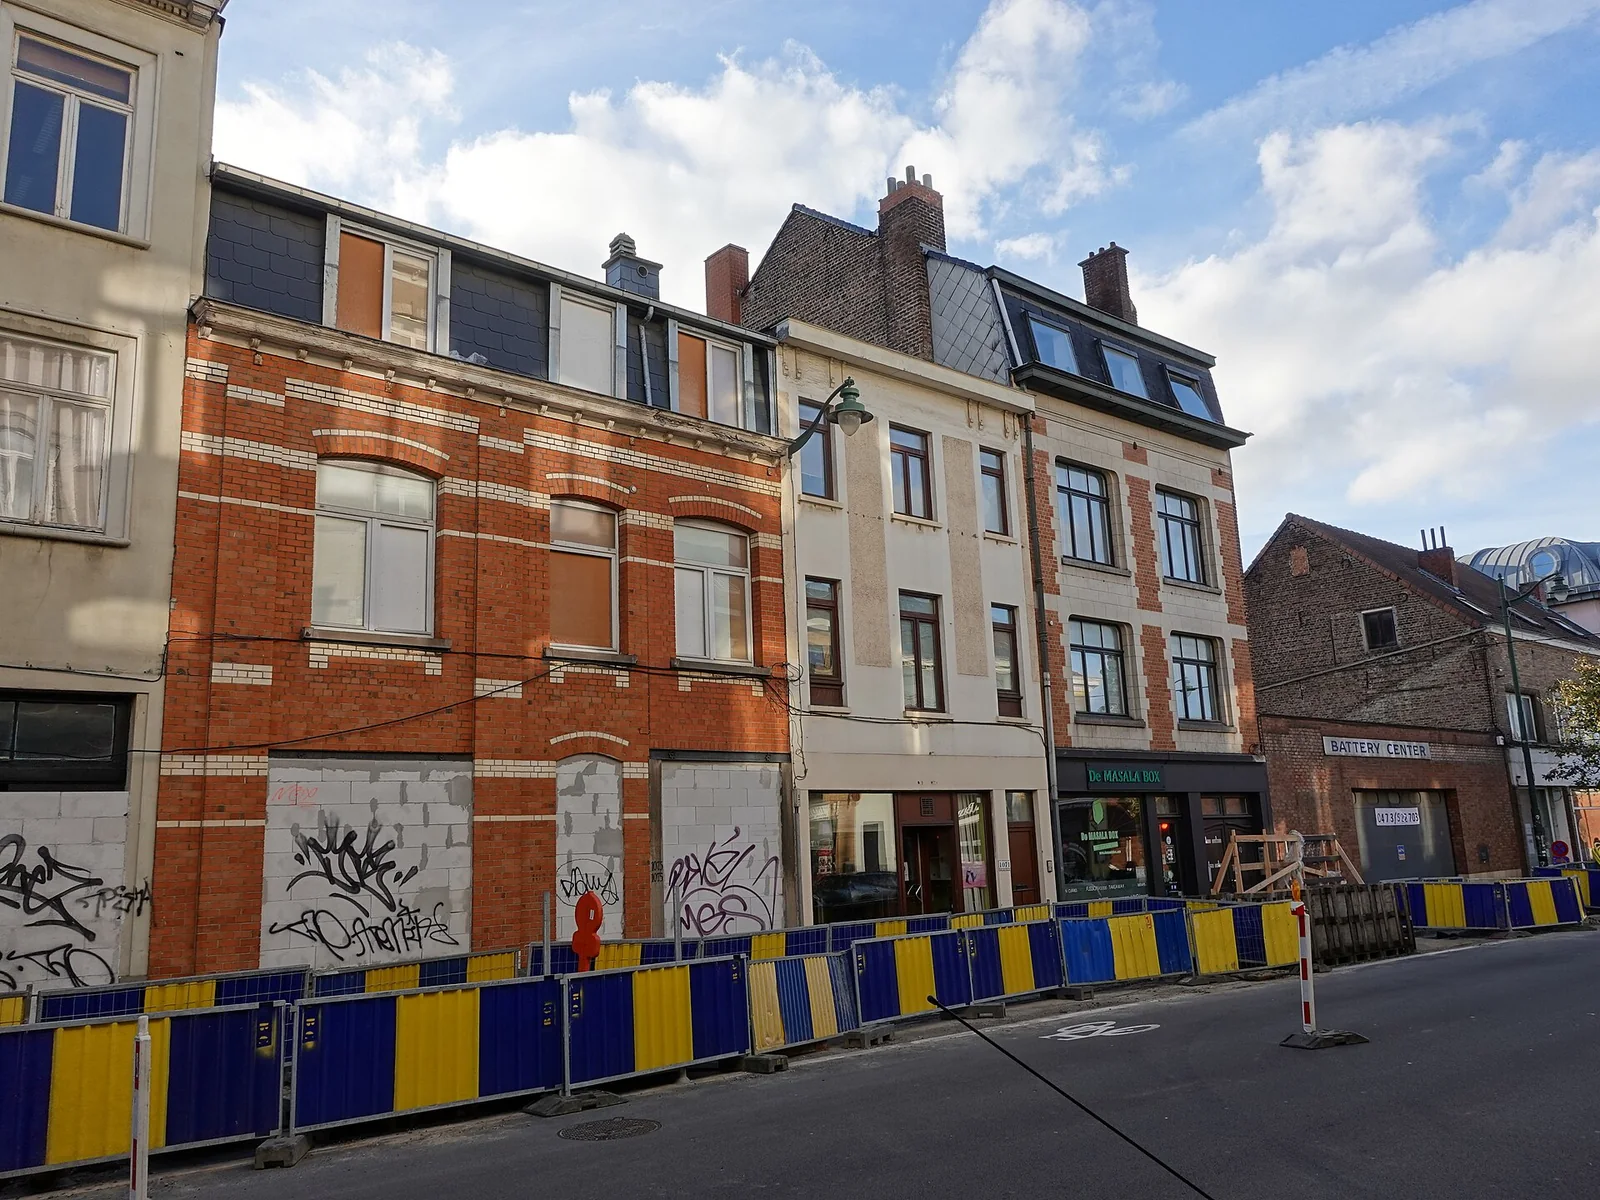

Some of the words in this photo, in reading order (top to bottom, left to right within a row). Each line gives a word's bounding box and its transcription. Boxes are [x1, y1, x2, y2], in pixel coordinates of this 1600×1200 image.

[1330, 740, 1380, 754] BATTERY
[1386, 743, 1426, 757] CENTER
[1088, 769, 1102, 782] De
[1103, 769, 1141, 783] MASALA
[1142, 770, 1161, 783] BOX
